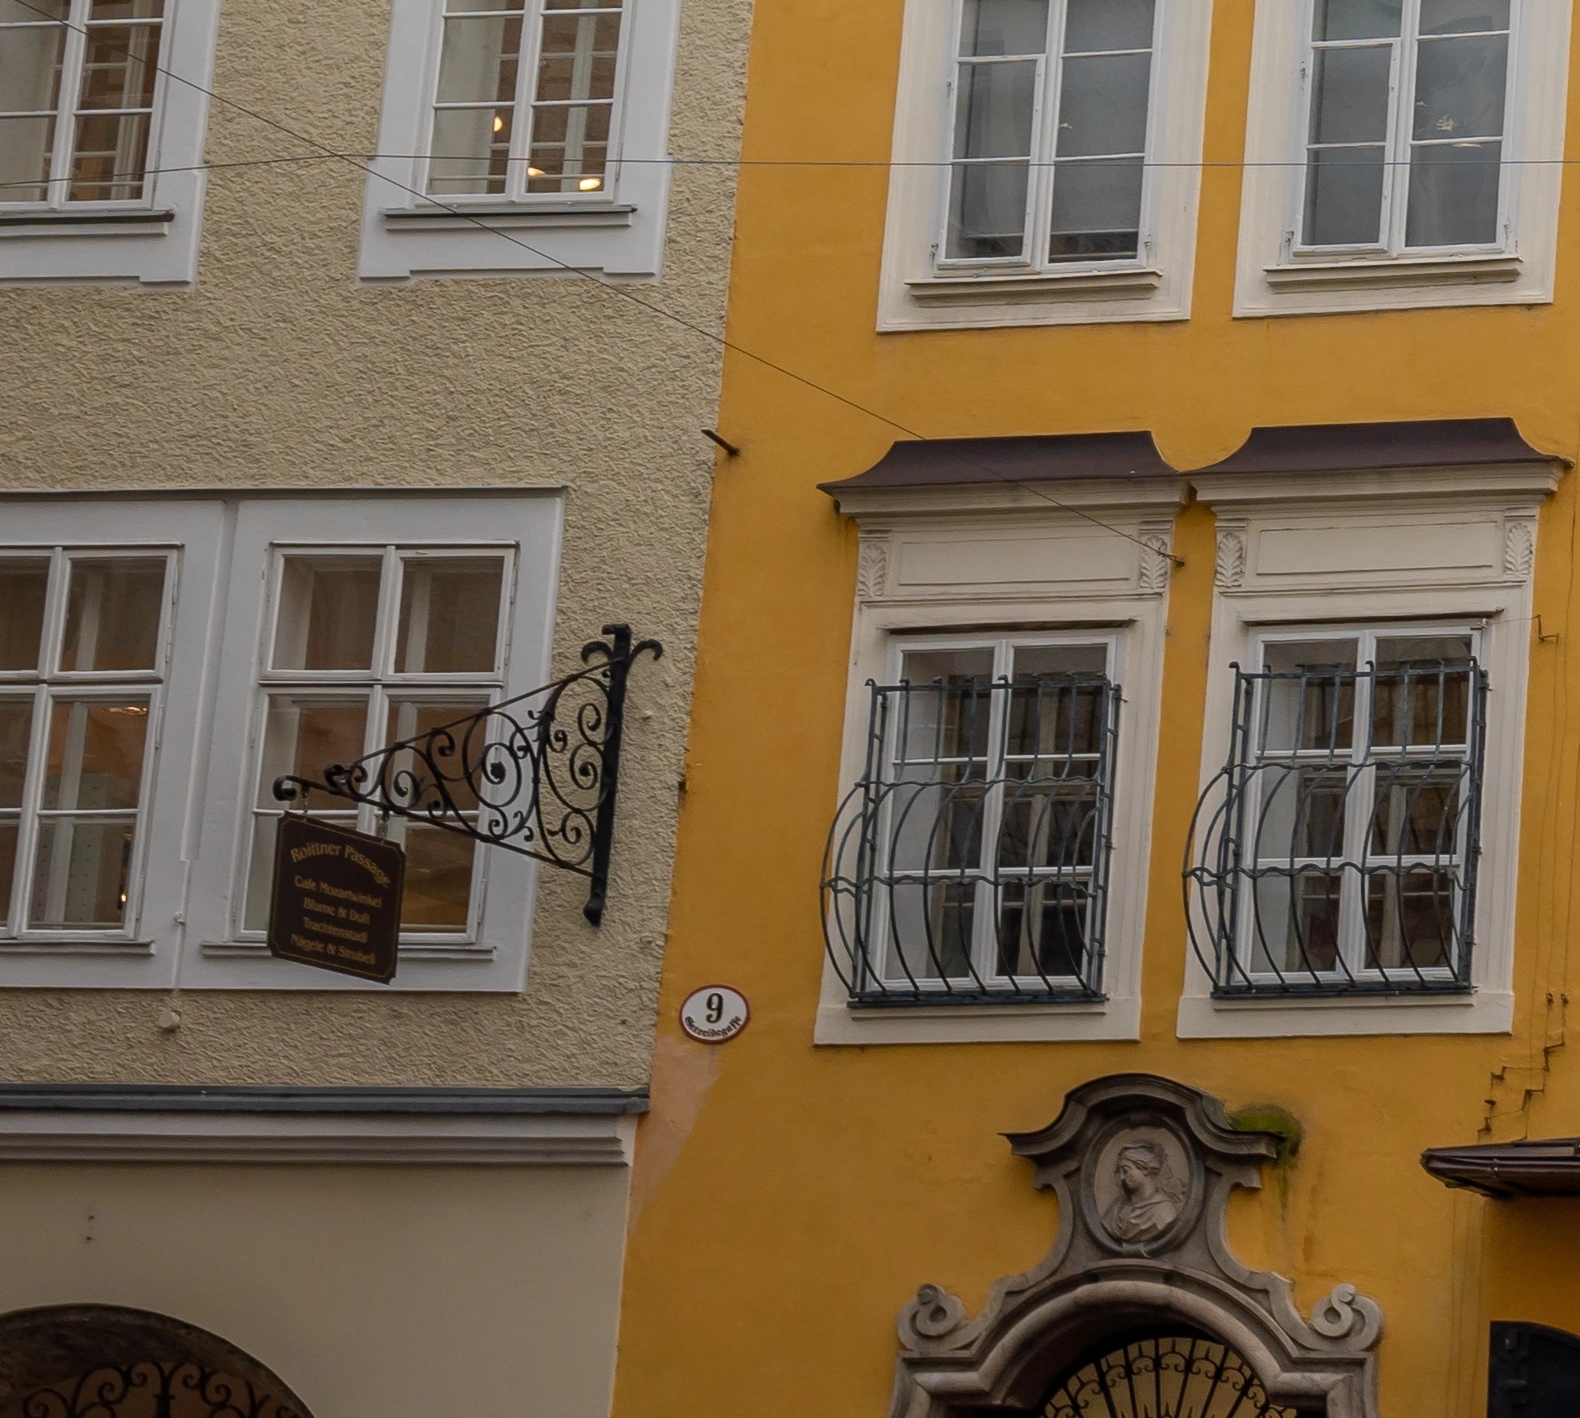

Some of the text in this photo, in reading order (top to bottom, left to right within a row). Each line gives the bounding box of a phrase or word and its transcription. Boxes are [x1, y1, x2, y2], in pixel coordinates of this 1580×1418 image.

[290, 842, 391, 888] Roittner Passage
[337, 906, 347, 919] &
[326, 943, 337, 956] &
[706, 993, 723, 1024] 9
